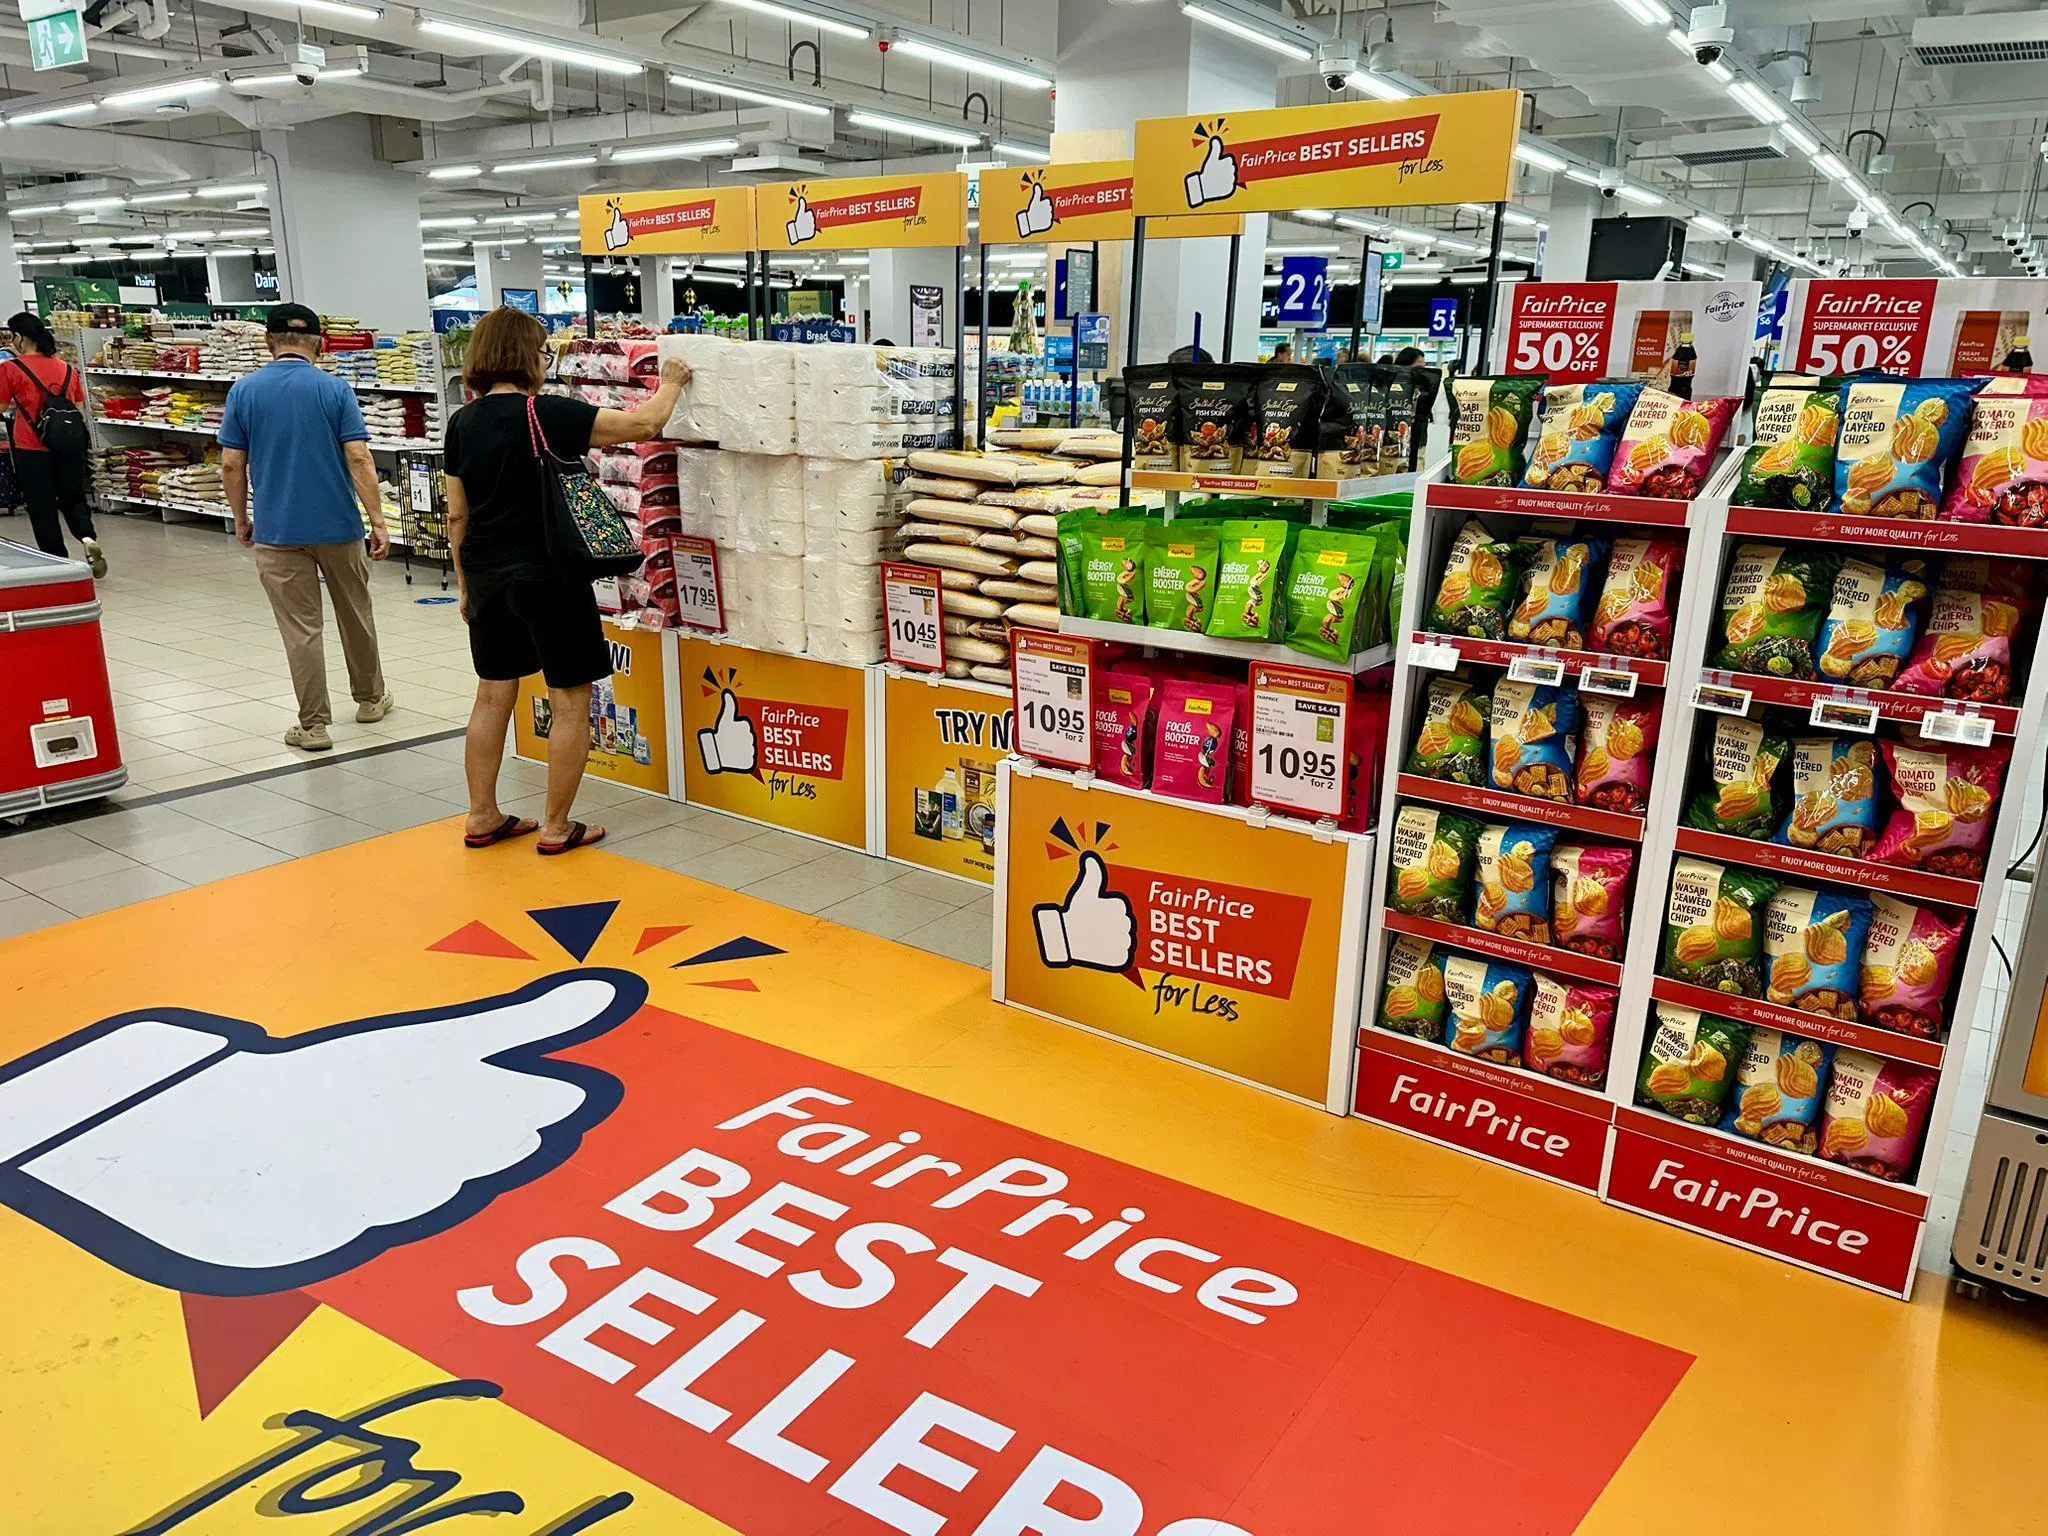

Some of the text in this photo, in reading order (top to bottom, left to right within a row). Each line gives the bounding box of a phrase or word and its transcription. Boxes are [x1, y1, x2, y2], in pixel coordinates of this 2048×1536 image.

[1240, 129, 1426, 169] FairPrice BEST SELLERS
[1398, 157, 1444, 184] for Less
[1055, 187, 1127, 208] FairPrice BEST
[816, 196, 916, 219] FairPrice BEST SELLERS
[629, 207, 711, 229] FairPrice BEST SELLERS
[902, 215, 928, 233] for Less
[254, 272, 280, 292] Dairy
[1284, 273, 1306, 311] 2
[1311, 273, 1324, 311] 2
[1521, 294, 1608, 315] FairPrice
[1704, 300, 1745, 316] FairPrice
[1816, 293, 1923, 315] FairPrice
[1432, 309, 1447, 331] 5
[1518, 320, 1604, 330] SUPERMARKET EXCLUSIVE
[1759, 316, 1771, 326] S6
[1812, 321, 1918, 332] SUPERMARKET EXCLUSIVE
[806, 329, 829, 342] Bread
[1513, 332, 1601, 371] 50%
[1805, 334, 1912, 376] 50%
[1570, 360, 1598, 372] OFF
[1136, 396, 1172, 408] Salted Egg
[1189, 398, 1233, 411] Salted Egg
[1636, 400, 1669, 412] TOMATO
[1632, 409, 1667, 420] LAYERED
[1761, 404, 1794, 415] WASABI
[1848, 410, 1873, 421] CORN
[1629, 418, 1653, 429] CHIPS
[1758, 413, 1797, 424] SEAWEED
[1845, 421, 1885, 433] LAYERED
[1843, 433, 1870, 445] CHIPS
[1969, 431, 1999, 442] CHIPS
[1234, 482, 1256, 490] SELLERS
[1517, 498, 1536, 509] ENJOY
[1536, 499, 1556, 511] MORE
[1556, 501, 1584, 512] QUALITY
[1583, 503, 1595, 515] for
[1840, 525, 1958, 545] ENJOY MORE QUALITY for Less
[1088, 558, 1114, 571] ENERGY
[1222, 562, 1250, 573] ENERGY
[1733, 563, 1763, 575] WASABI
[1087, 571, 1116, 582] BOOSTER
[1153, 566, 1181, 579] ENERGY
[1220, 573, 1250, 585] BOOSTER
[1296, 571, 1328, 586] ENERGY
[1730, 573, 1763, 585] SEAWEED
[1152, 578, 1184, 591] BOOSTER
[1292, 584, 1329, 597] BOOSTER
[1727, 584, 1757, 595] LAYERED
[680, 584, 717, 607] 17.95
[1724, 595, 1744, 606] CHIPS
[892, 618, 937, 644] 10.45
[1932, 621, 1960, 631] CHIPS
[922, 642, 937, 650] each
[1051, 664, 1067, 672] SAVE
[1301, 680, 1325, 691] SELLERS
[1256, 695, 1279, 703] FAIRPRICE
[1297, 702, 1338, 715] SAVE $4.45
[761, 706, 820, 727] FairPrice
[1023, 700, 1085, 734] 10.95
[1095, 710, 1117, 723] FOCUS
[935, 710, 985, 745] TRY
[1095, 721, 1124, 735] BOOSTER
[1165, 721, 1192, 734] FOCUS
[1719, 723, 1750, 736] FairPrice
[763, 726, 802, 747] BEST
[1065, 731, 1083, 743] for 2
[1164, 733, 1200, 746] BOOSTER
[1717, 736, 1748, 752] WASABI
[764, 746, 833, 772] SELLERS
[1258, 743, 1336, 780] 10.95
[1715, 747, 1750, 763] SEAWEED
[769, 770, 817, 801] for Less
[1310, 778, 1333, 790] for 2
[1400, 816, 1427, 827] FairPrice
[1397, 827, 1426, 840] WASABI
[1395, 836, 1428, 851] SEAWEED
[1781, 855, 1890, 882] ENJOY MORE QUALITY for Less
[1676, 870, 1709, 882] FairPrice
[1675, 882, 1708, 896] WASABI
[1148, 880, 1255, 919] FairPrice
[1673, 891, 1712, 908] SEAWEED
[1671, 903, 1707, 918] LAYERED
[1150, 908, 1220, 944] BEST
[1670, 912, 1694, 926] CHIPS
[1149, 938, 1273, 985] SELLERS
[1393, 948, 1419, 963] WASABI
[1391, 956, 1418, 972] SEAWEED
[1447, 969, 1473, 980] FairPrice
[1447, 980, 1465, 992] CORN
[1152, 971, 1239, 1023] for Less
[1447, 991, 1475, 1004] LAYERED
[1753, 1009, 1858, 1039] ENJOY MORE QUALITY for Less
[1653, 1045, 1670, 1062] CHIPS
[1655, 1036, 1683, 1058] LAYERED
[1389, 1075, 1570, 1157] FairPrice
[1726, 1147, 1828, 1182] ENJOY MORE QUALITY for Less
[715, 1086, 1300, 1325] FairPrice
[1648, 1159, 1870, 1254] FairPrice
[601, 1147, 1044, 1349] BEST
[456, 1235, 1262, 1536] SELLER
[120, 1378, 526, 1536] for
